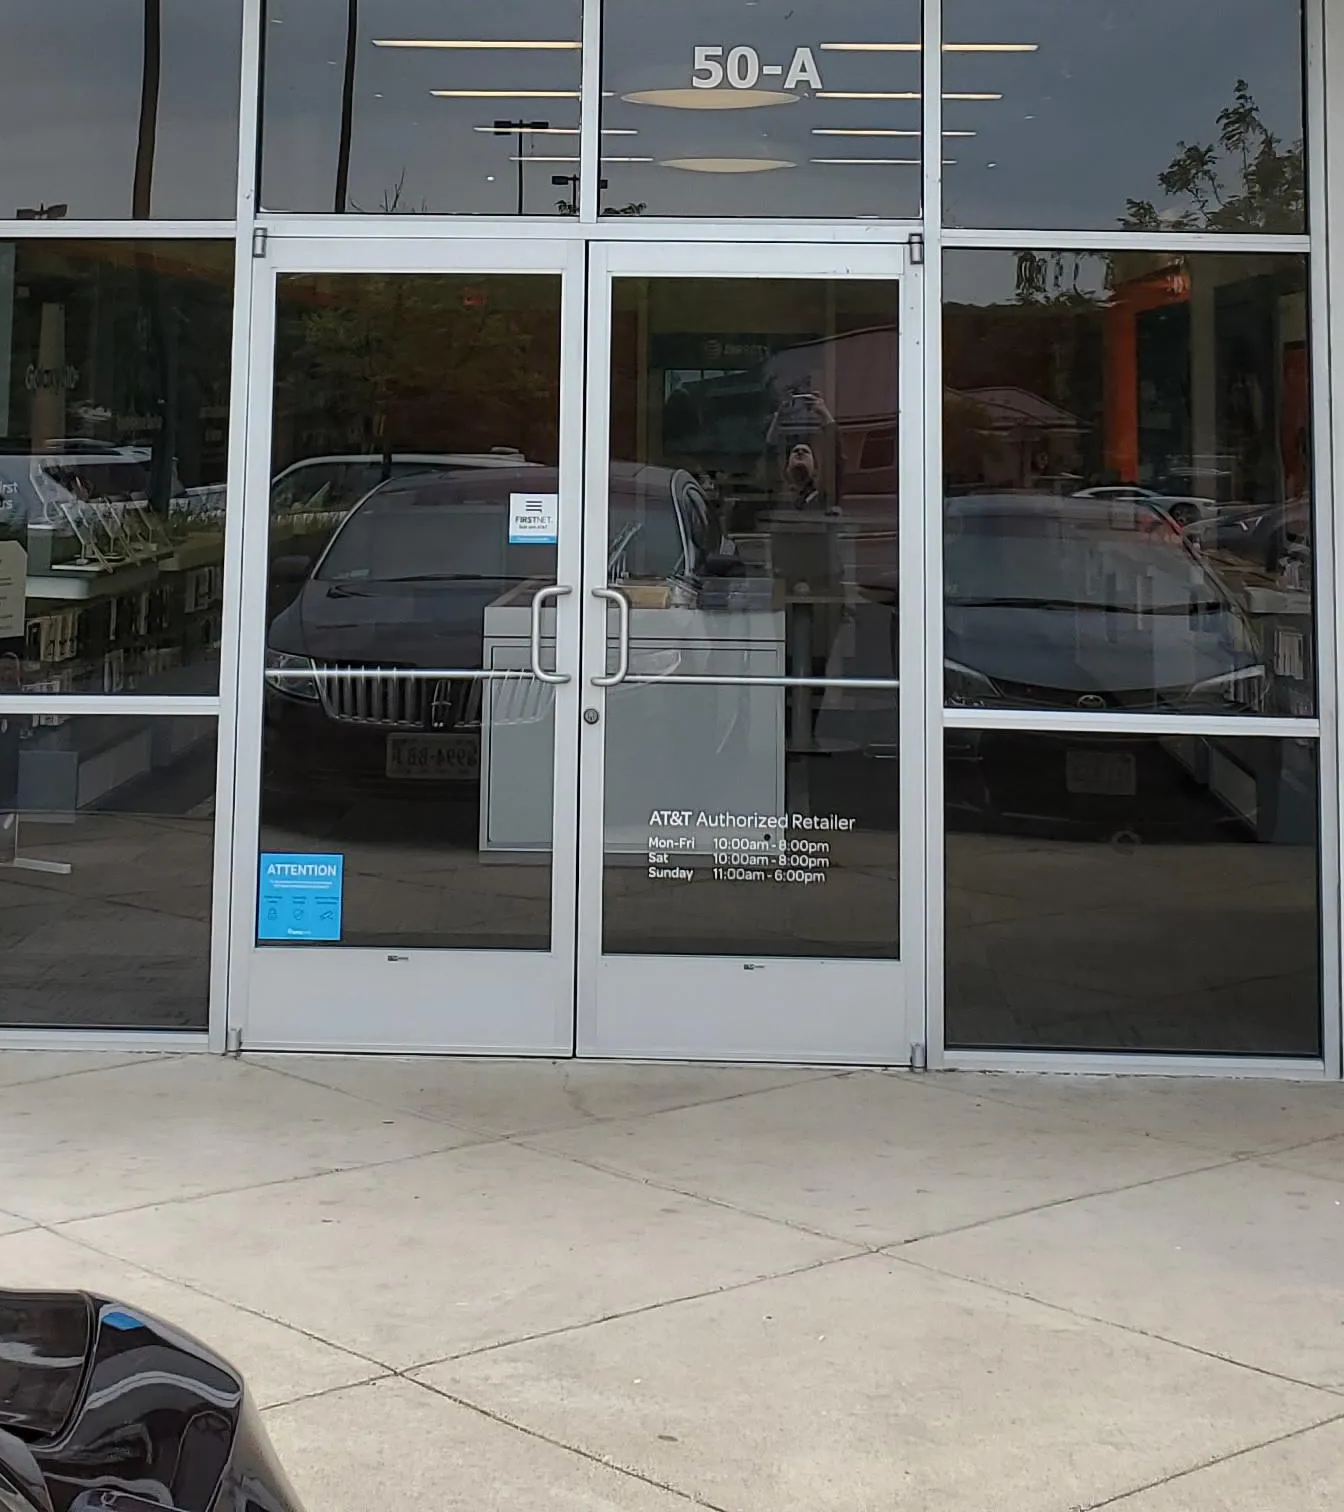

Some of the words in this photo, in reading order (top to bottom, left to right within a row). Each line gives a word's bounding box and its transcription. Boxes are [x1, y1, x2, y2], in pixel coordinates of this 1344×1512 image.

[691, 46, 824, 90] 50-A
[648, 810, 693, 827] AT&T
[695, 811, 789, 829] Authorized
[791, 813, 857, 831] Retailer
[648, 837, 695, 850] Mon-Fri
[713, 837, 769, 851] 10:00am
[778, 839, 830, 854] 8:00pm
[648, 852, 669, 864] Sat
[713, 852, 769, 866] 10:00am
[778, 854, 830, 869] 8:00pm
[267, 863, 337, 877] ATTENTION
[648, 866, 694, 882] Sunday
[713, 868, 765, 881] 11:00am
[774, 869, 826, 885] 6:00pm
